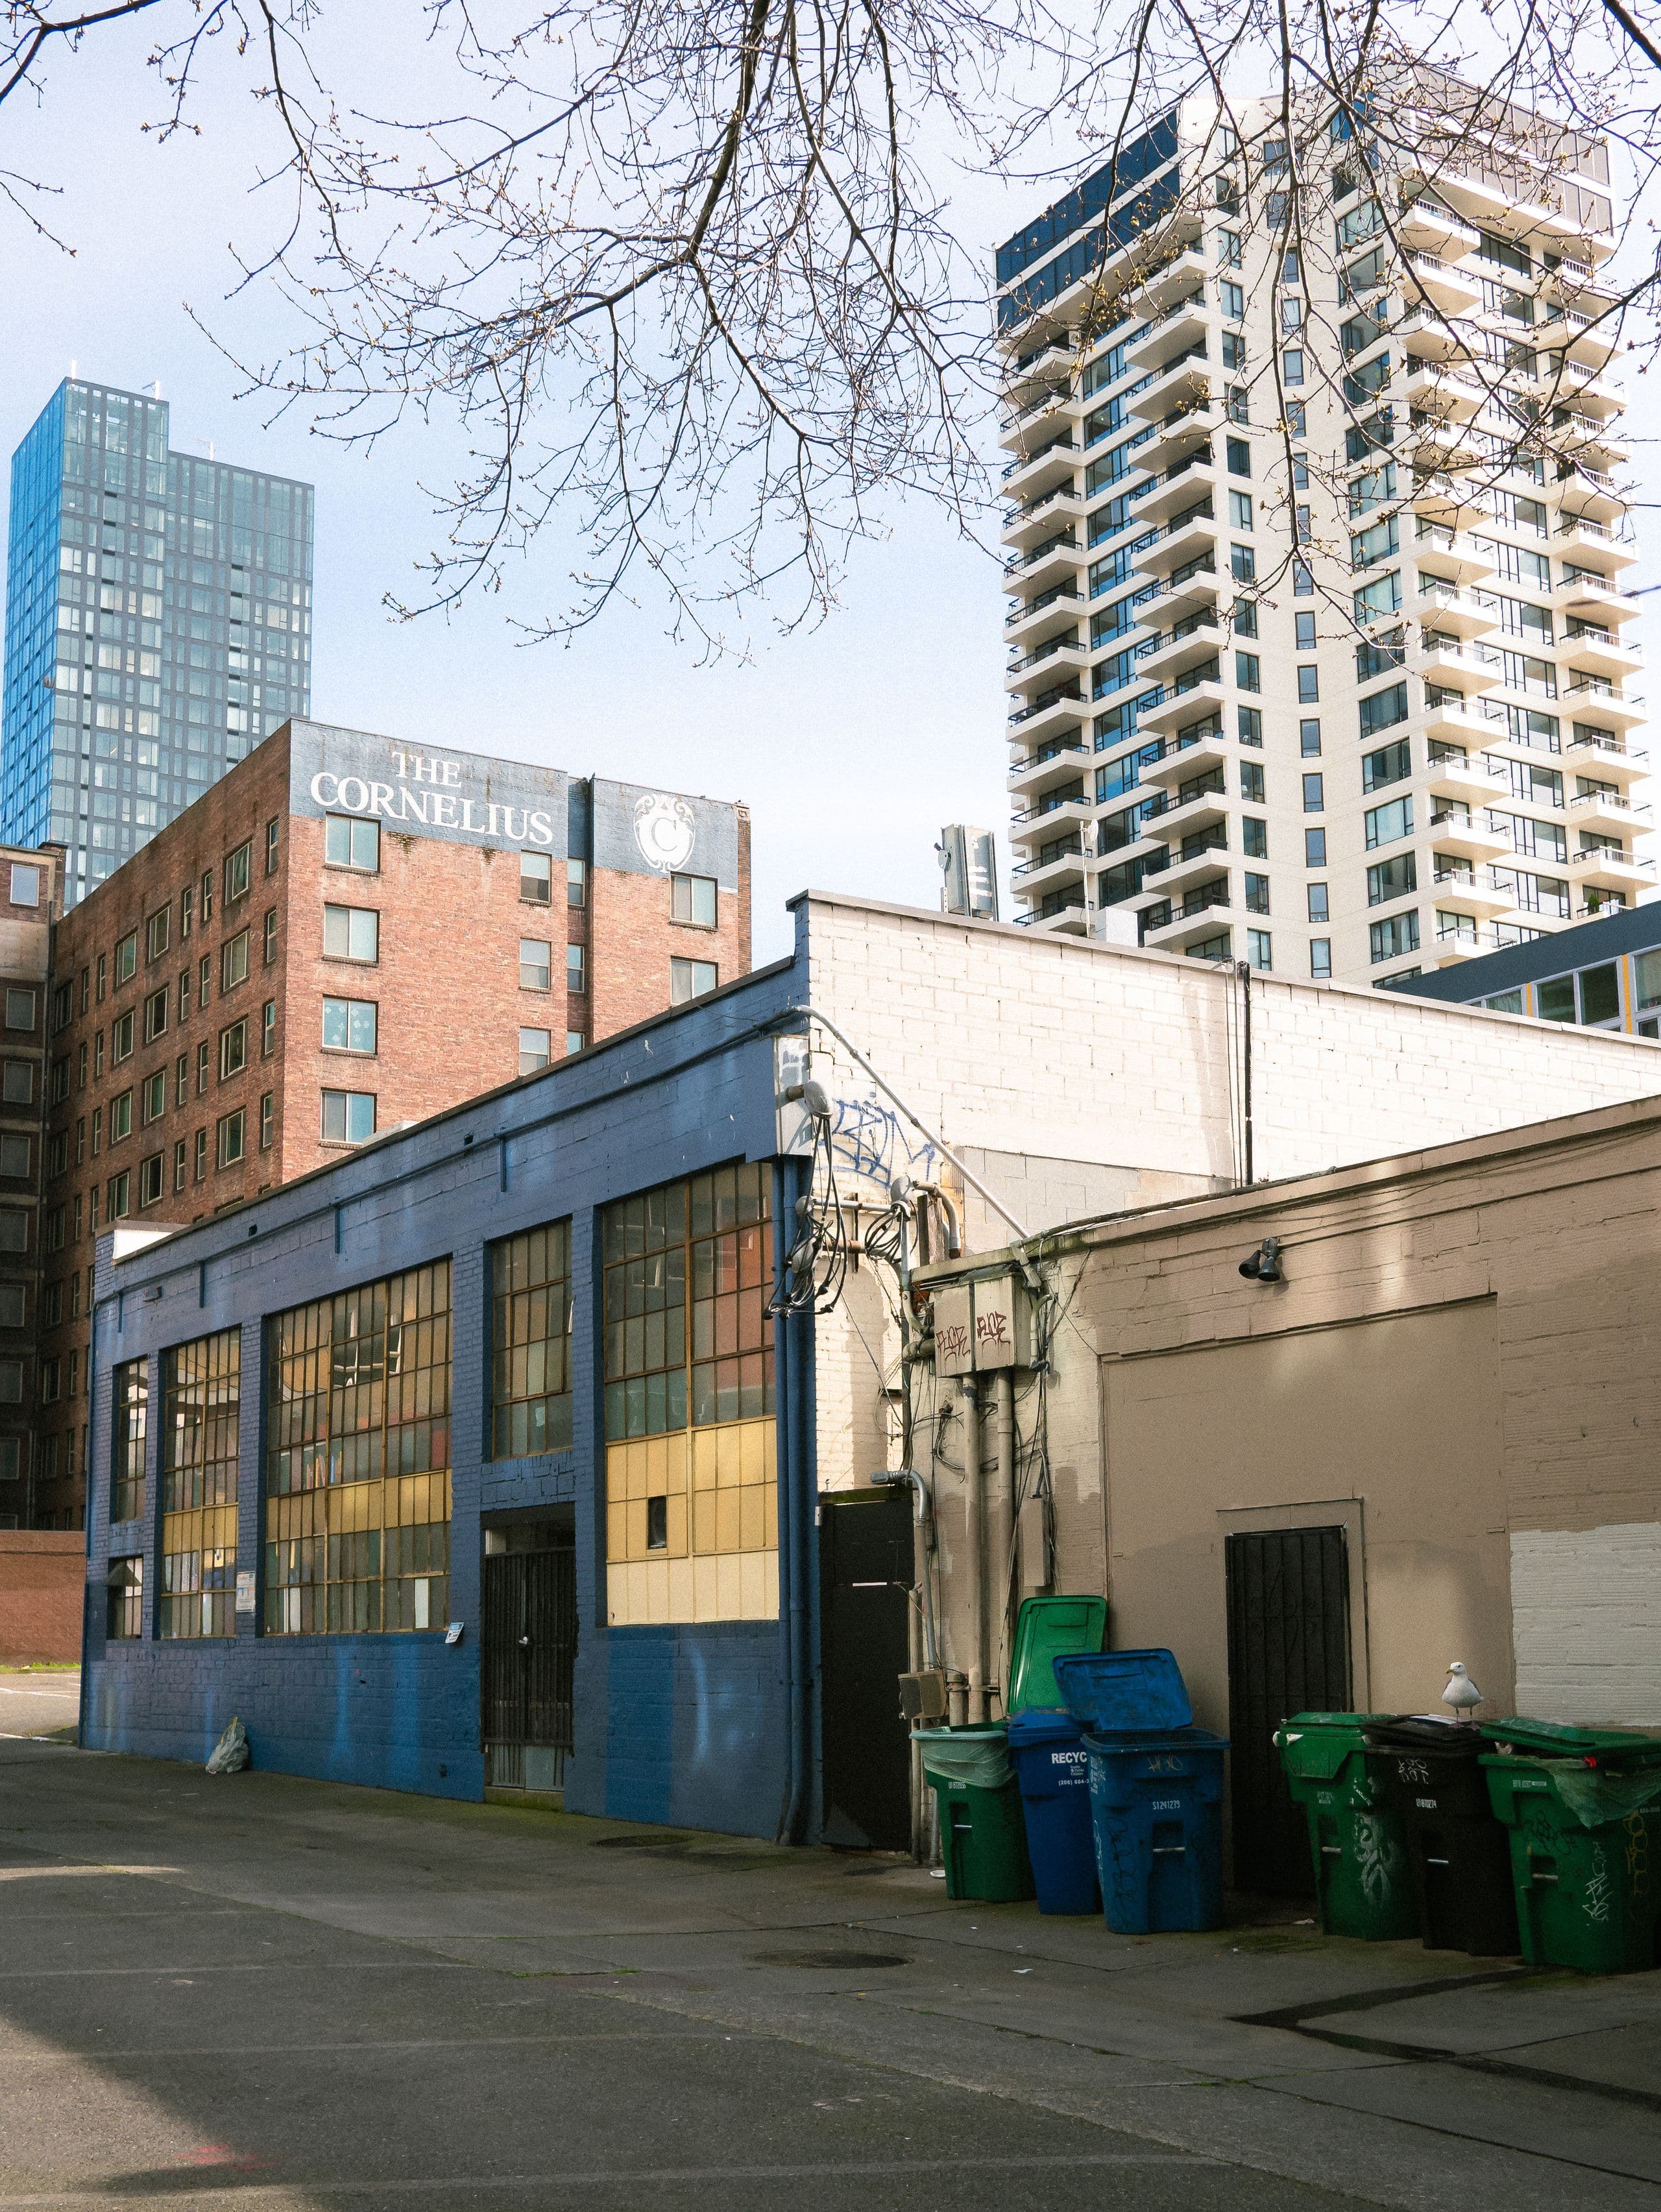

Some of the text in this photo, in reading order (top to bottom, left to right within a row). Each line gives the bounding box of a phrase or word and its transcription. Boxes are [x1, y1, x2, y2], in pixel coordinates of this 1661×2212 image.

[391, 751, 461, 788] THE
[310, 772, 553, 845] CORNELIUS
[650, 817, 678, 852] C
[1051, 1751, 1087, 1764] RECYC
[1152, 1800, 1180, 1810] S1241279
